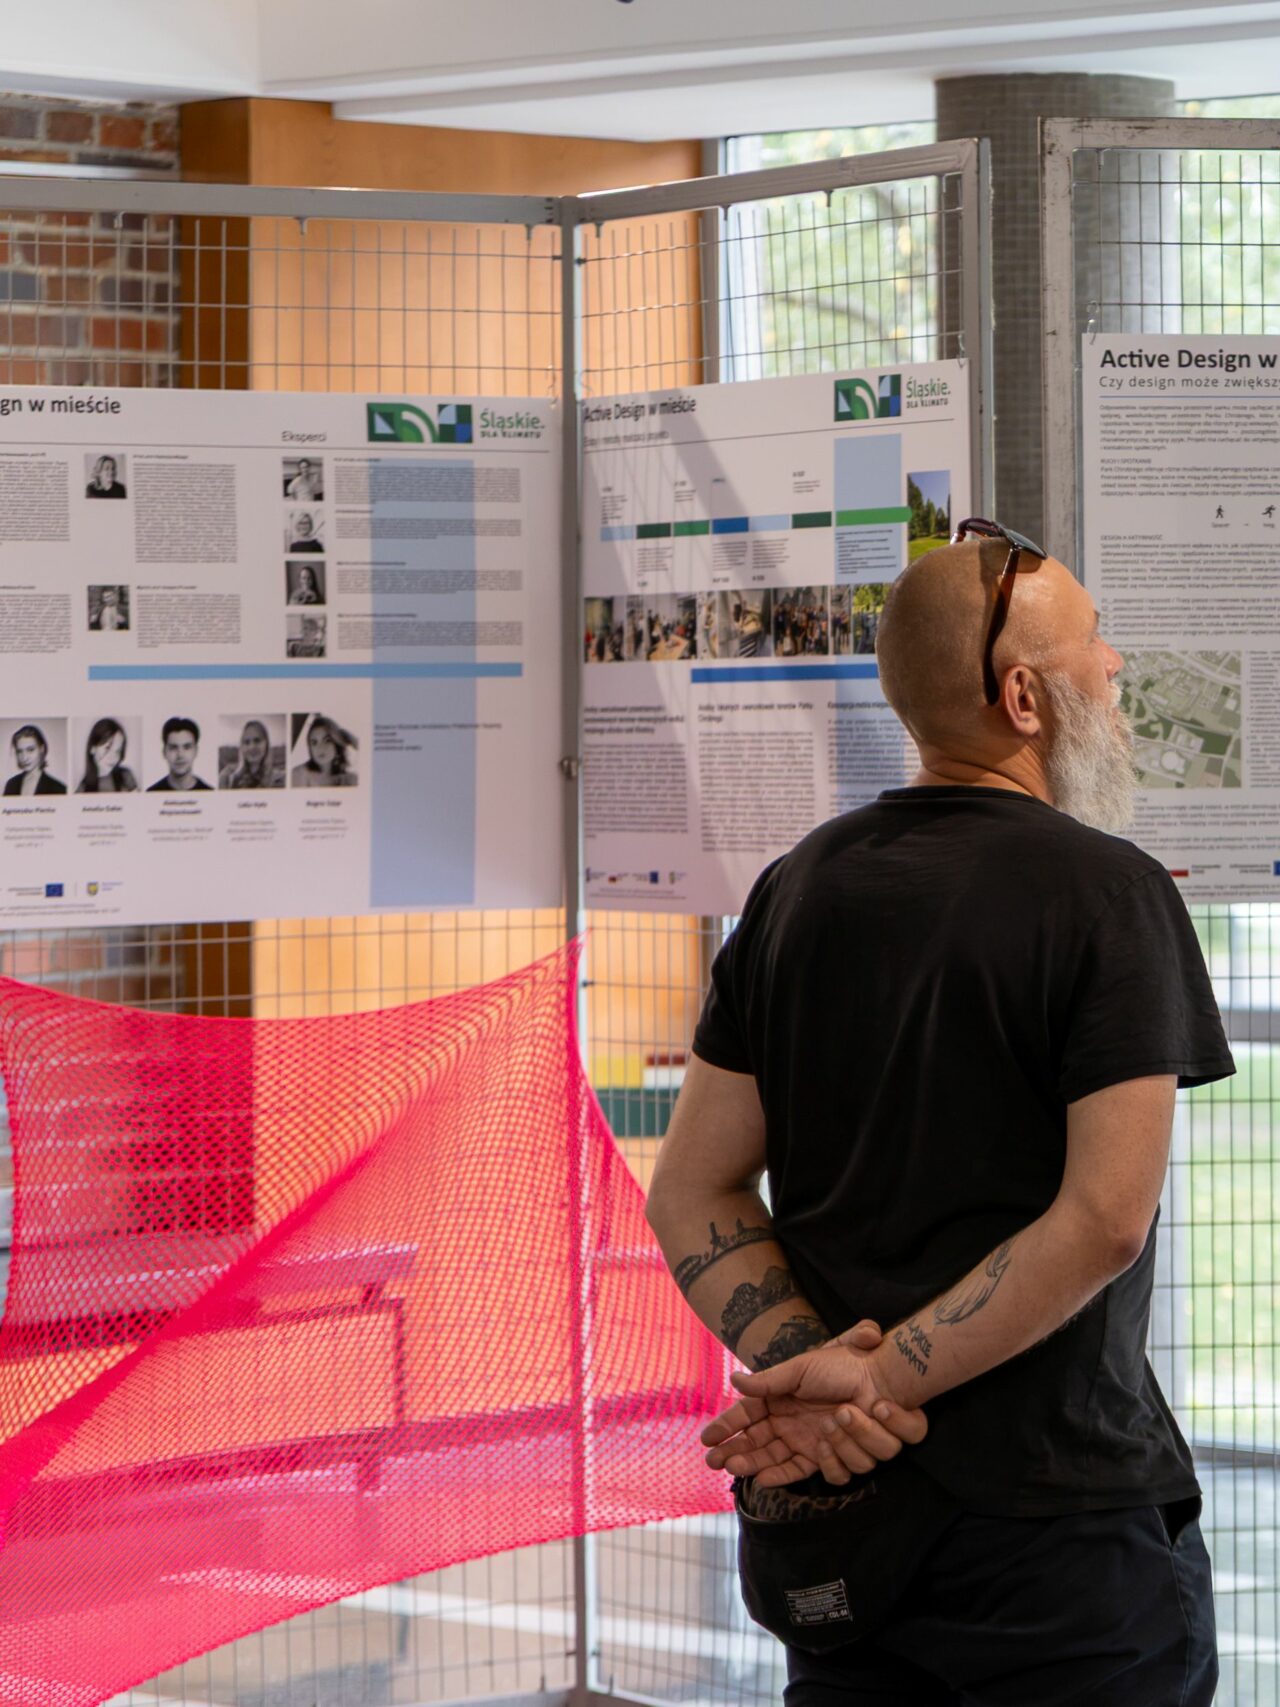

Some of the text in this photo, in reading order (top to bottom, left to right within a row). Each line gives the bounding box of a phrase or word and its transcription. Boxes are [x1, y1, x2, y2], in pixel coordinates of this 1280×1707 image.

[1100, 349, 1170, 368] Active
[1178, 349, 1251, 373] Design
[1258, 353, 1278, 368] w
[1099, 376, 1124, 390] Czy
[1129, 376, 1176, 390] design
[1181, 376, 1219, 388] może
[28, 399, 45, 412] w
[51, 395, 121, 414] mieście
